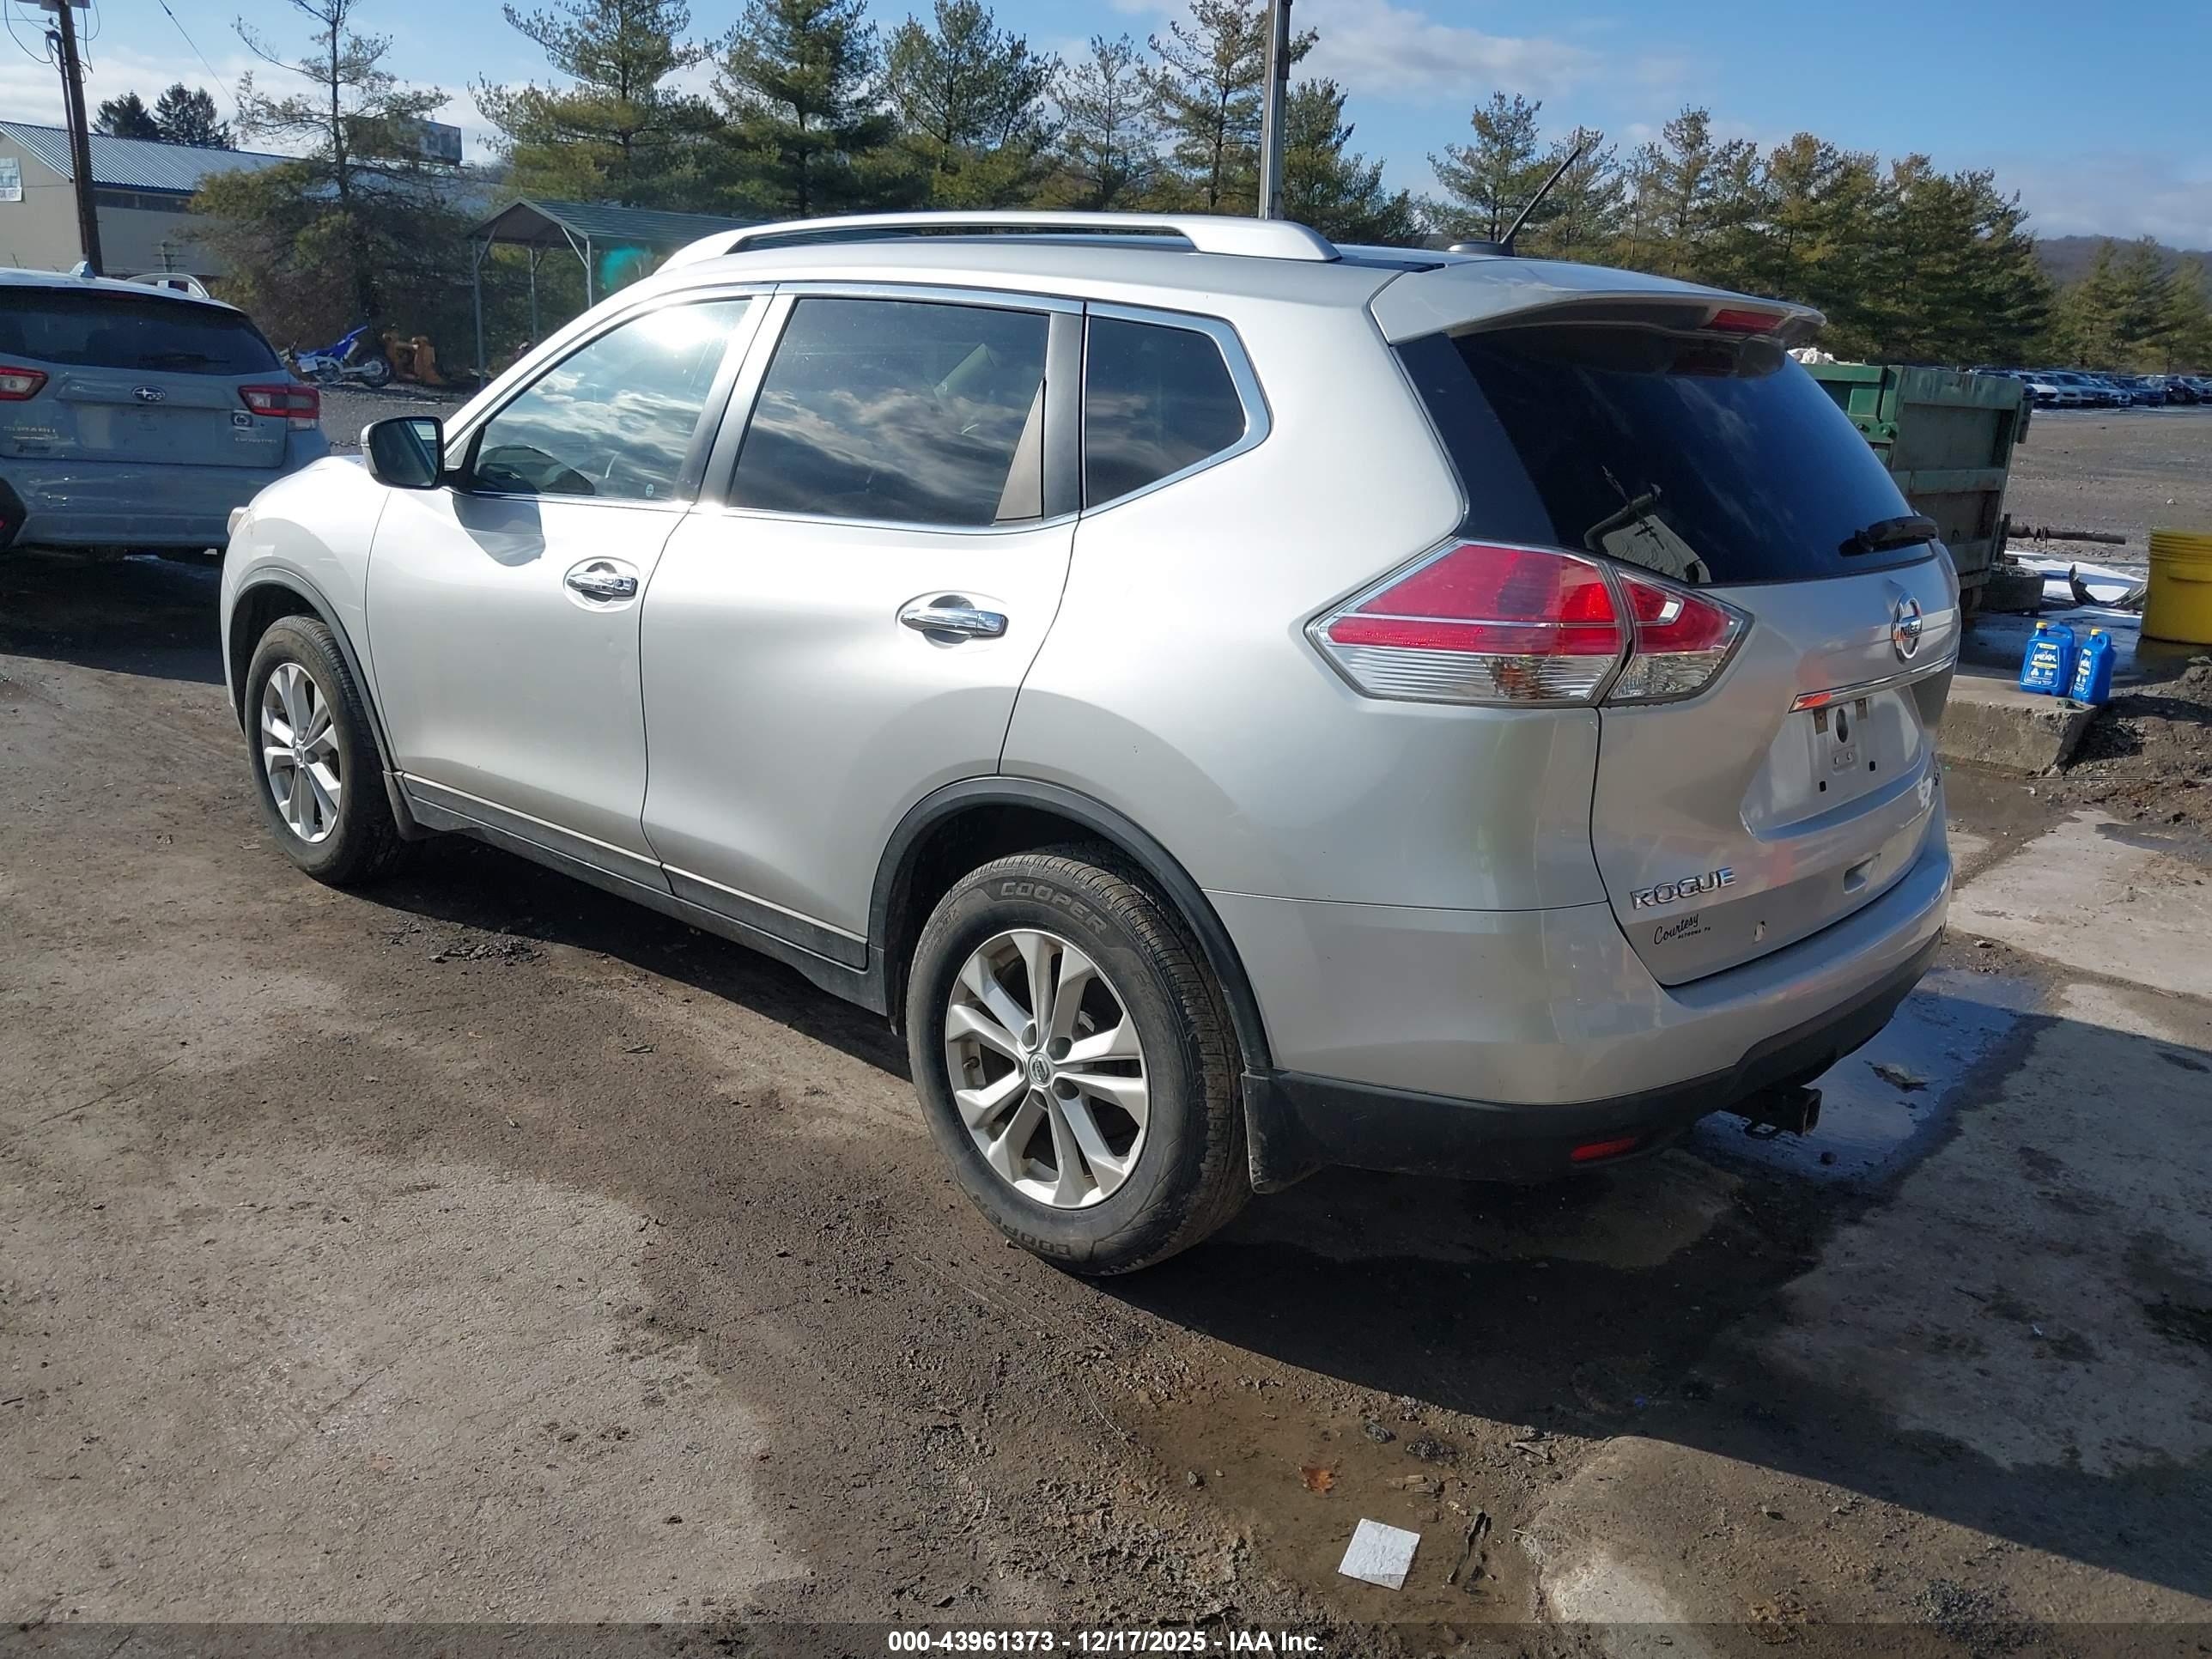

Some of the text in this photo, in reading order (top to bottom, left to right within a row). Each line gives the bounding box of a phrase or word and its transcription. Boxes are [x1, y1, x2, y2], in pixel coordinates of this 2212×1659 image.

[2033, 653, 2057, 662] PEAK
[1630, 866, 1736, 910] ROGUE
[1000, 882, 1107, 934] COOPER
[1654, 913, 1698, 945] Courtesy
